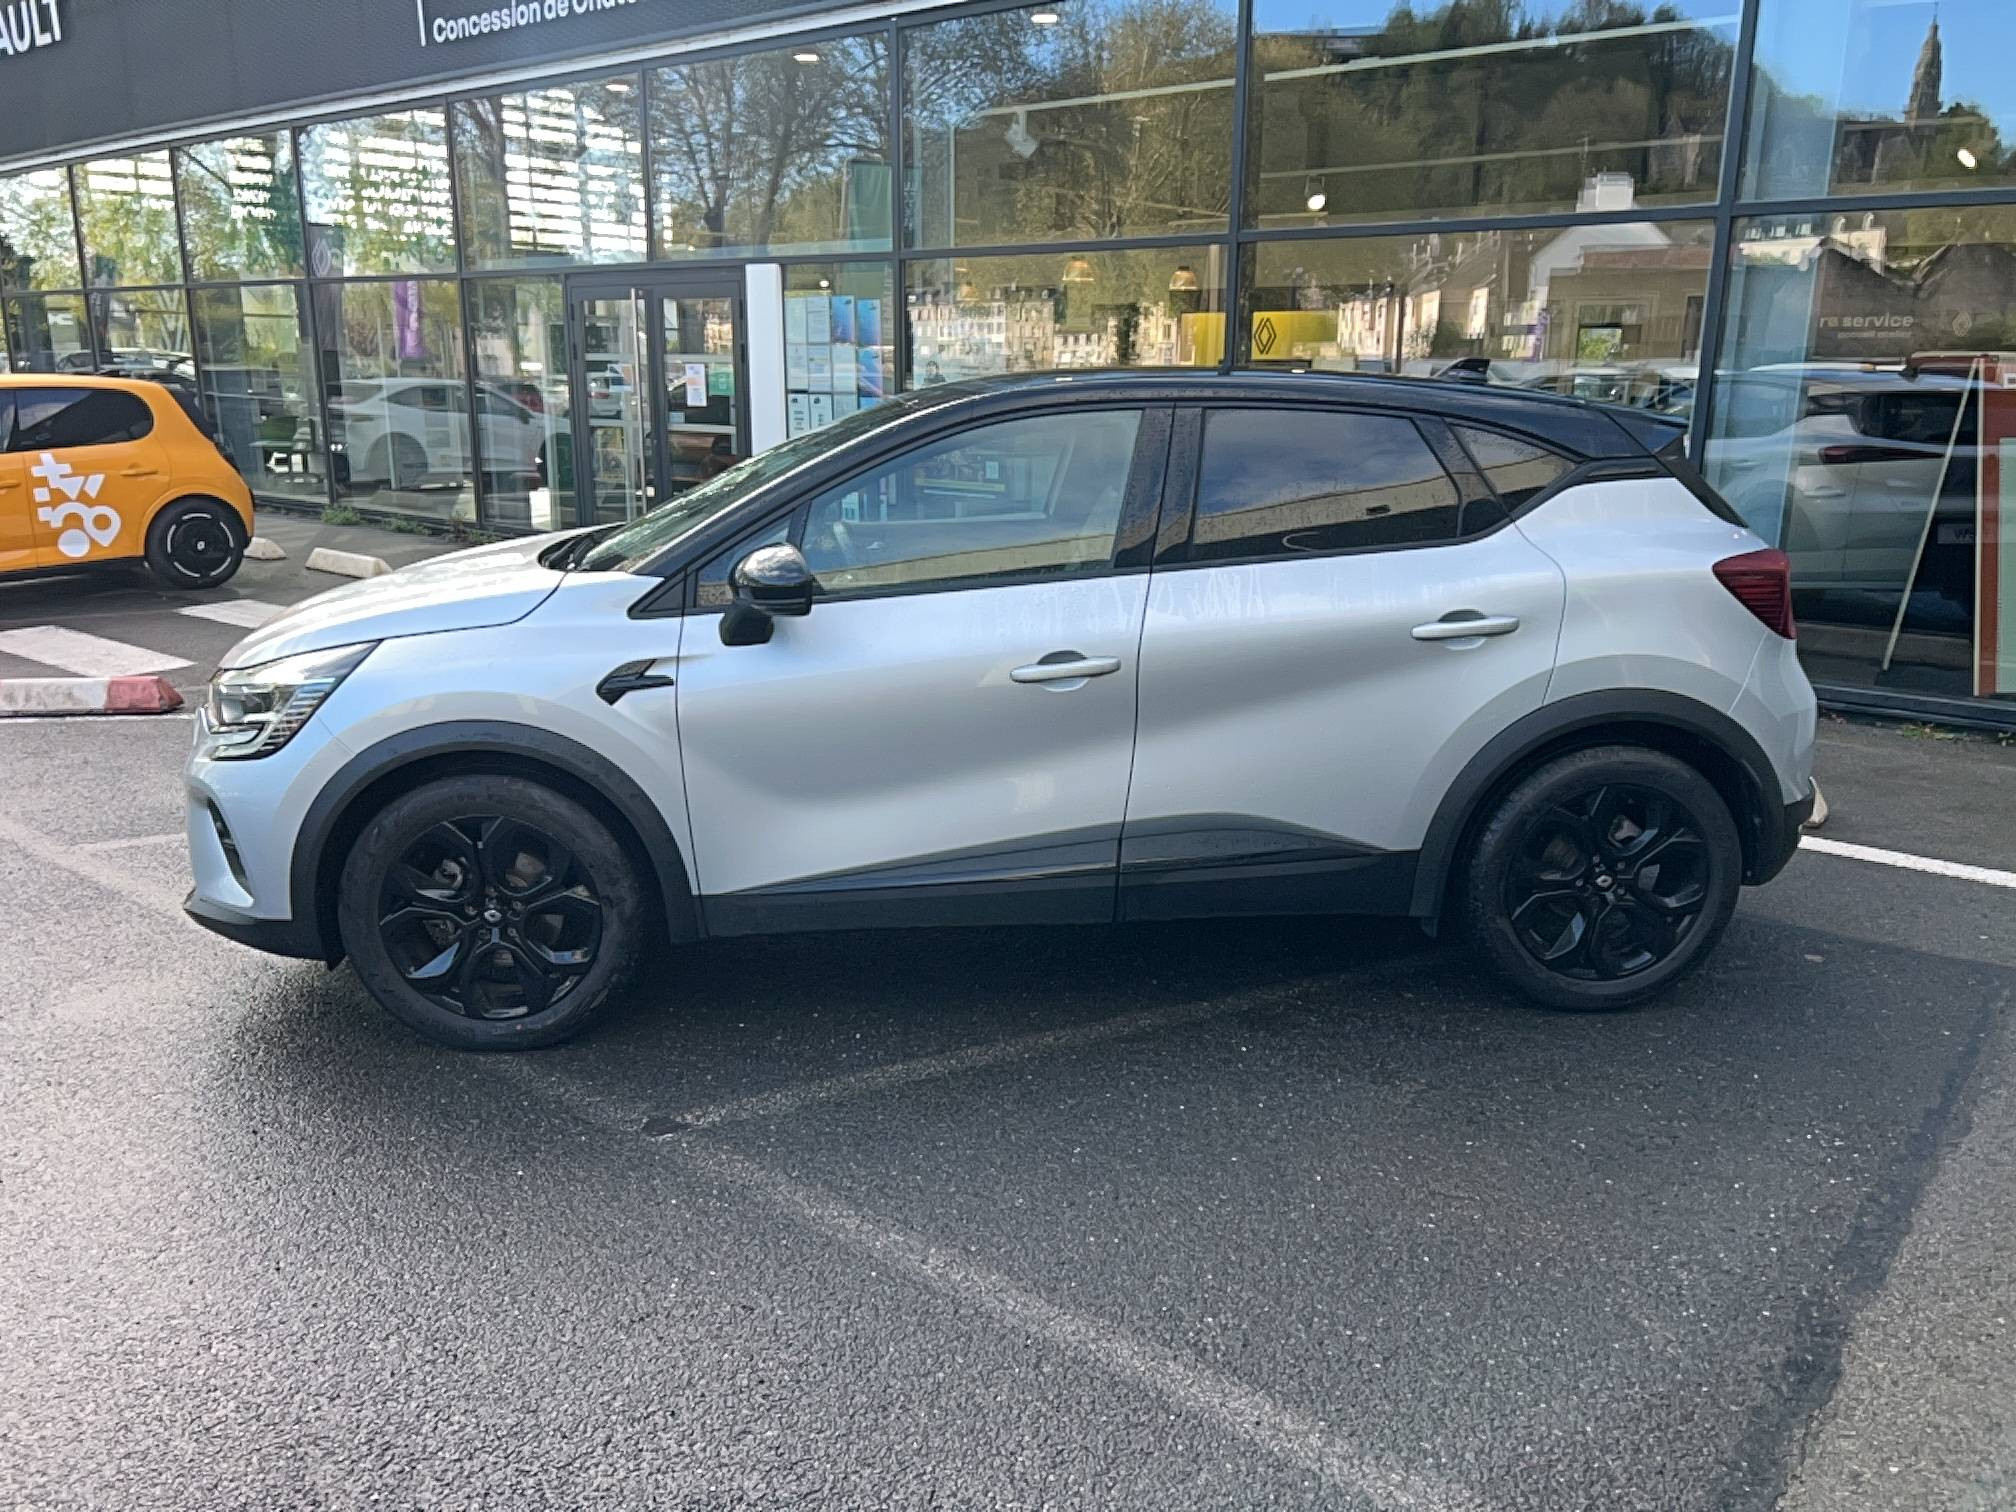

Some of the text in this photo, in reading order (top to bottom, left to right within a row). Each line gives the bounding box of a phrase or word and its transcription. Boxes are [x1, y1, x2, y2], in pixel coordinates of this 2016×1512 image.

[432, 0, 541, 43] Concession
[543, 0, 569, 20] de
[1842, 312, 1914, 328] service
